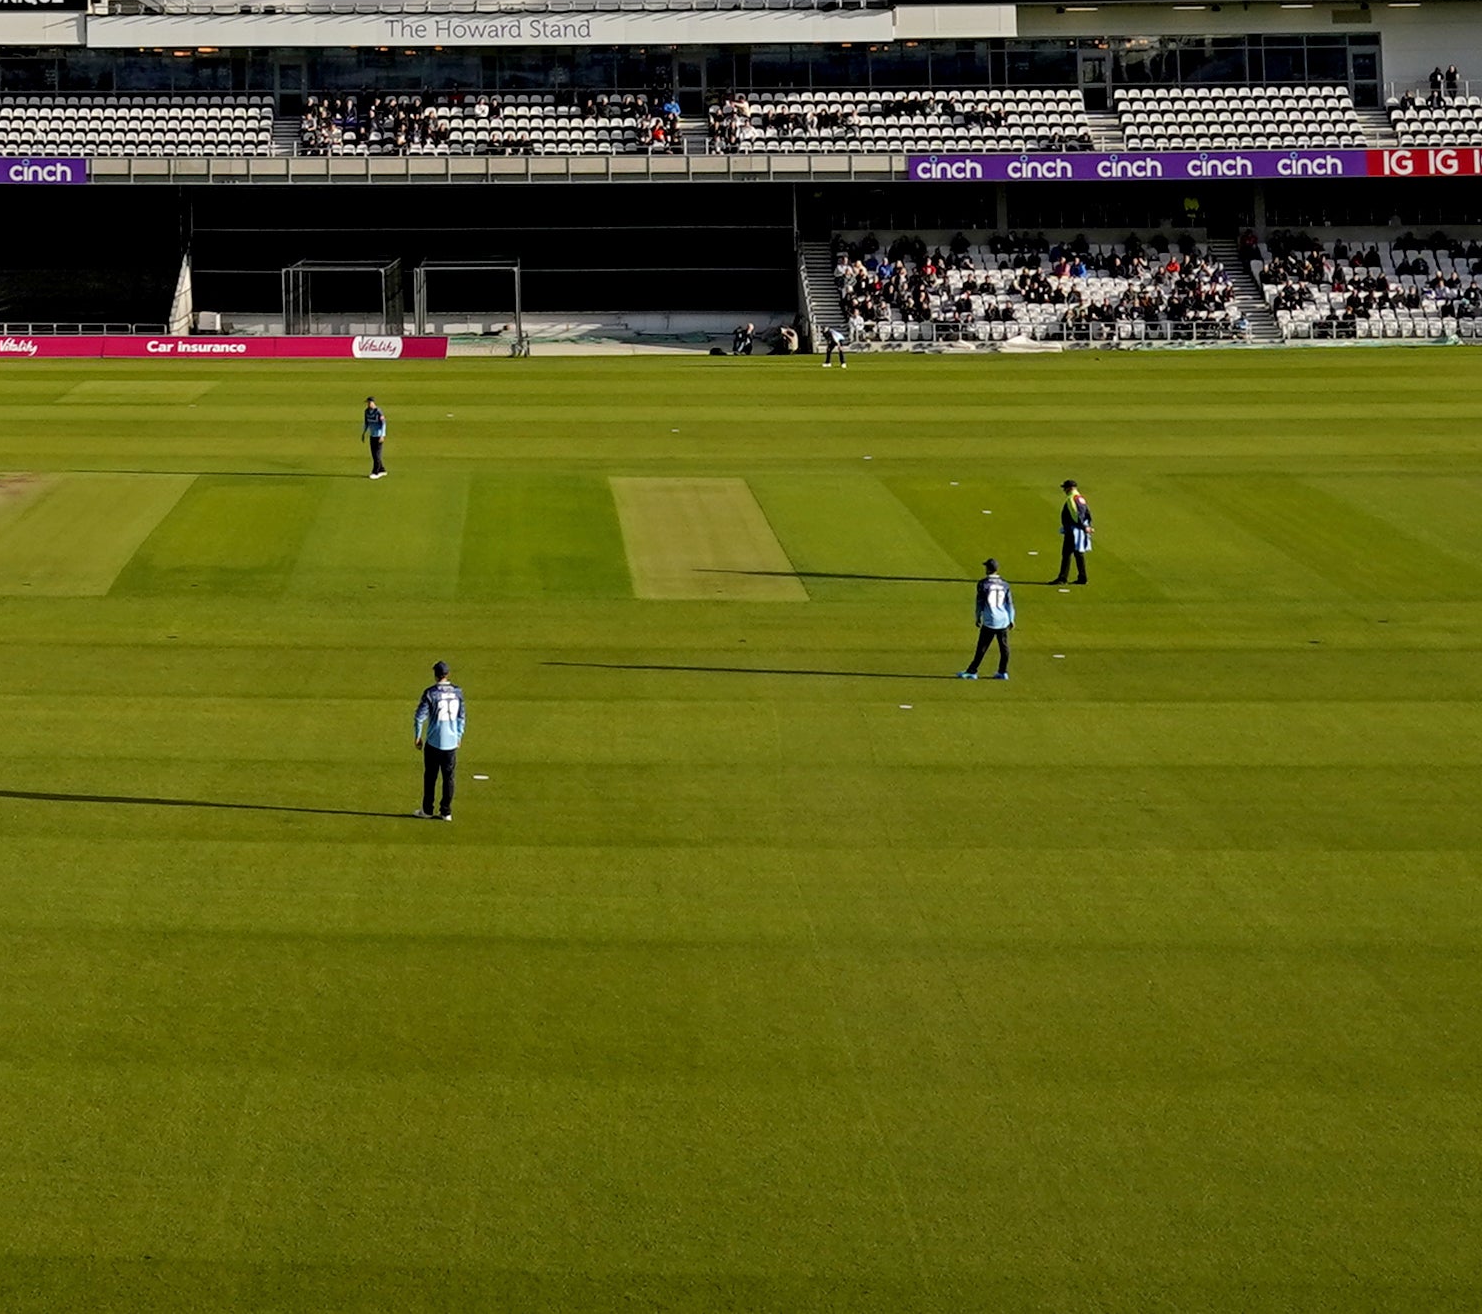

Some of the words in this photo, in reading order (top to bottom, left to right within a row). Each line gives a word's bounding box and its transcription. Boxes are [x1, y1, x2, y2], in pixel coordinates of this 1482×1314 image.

[385, 20, 427, 38] The
[435, 19, 522, 38] Howard
[530, 19, 591, 38] Stand
[9, 159, 71, 182] cinch
[916, 155, 982, 179] cinch
[1096, 154, 1162, 178] cinch
[1277, 151, 1343, 176] cinch
[1383, 150, 1414, 175] IG
[0, 339, 37, 356] Vitality
[147, 341, 175, 353] Car
[177, 341, 246, 353] insurance
[358, 338, 397, 355] Vitality
